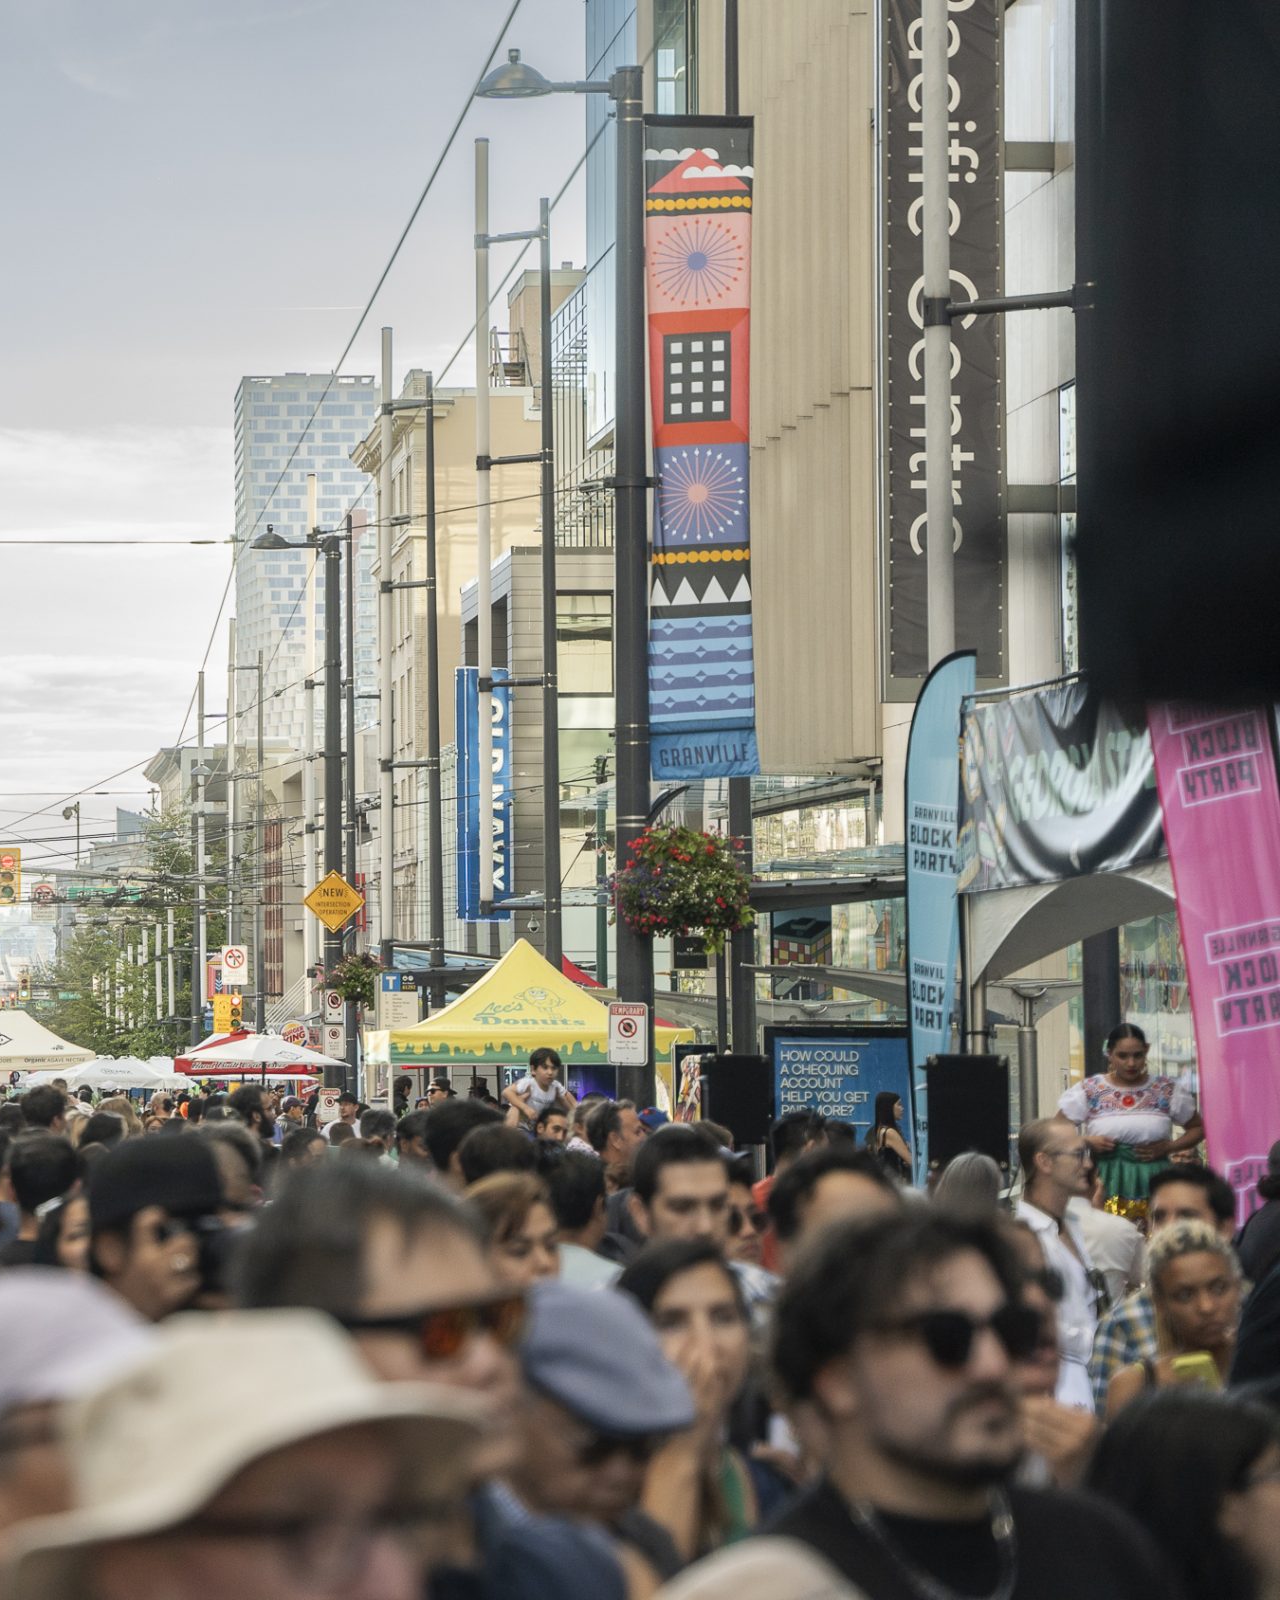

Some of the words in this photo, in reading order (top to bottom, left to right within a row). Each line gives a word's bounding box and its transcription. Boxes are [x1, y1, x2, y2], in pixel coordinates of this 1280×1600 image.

[907, 0, 979, 236] acific
[907, 268, 979, 556] Centre
[660, 743, 750, 767] GRANVILLE
[910, 824, 952, 848] BLOCK
[914, 850, 959, 873] PARTY
[322, 888, 344, 897] NEW
[474, 1002, 523, 1017] Lee's
[612, 1006, 644, 1015] TEMPORARY
[474, 1016, 586, 1026] Donuts
[282, 1026, 304, 1037] BURGER
[282, 1030, 306, 1043] KING
[781, 1051, 812, 1061] HOW
[814, 1051, 859, 1062] COULD
[780, 1064, 789, 1075] A
[791, 1064, 859, 1077] CHEQUING
[780, 1078, 843, 1089] ACCOUNT
[781, 1091, 813, 1102] HELP
[815, 1091, 841, 1103] YOU
[843, 1091, 869, 1103] GET
